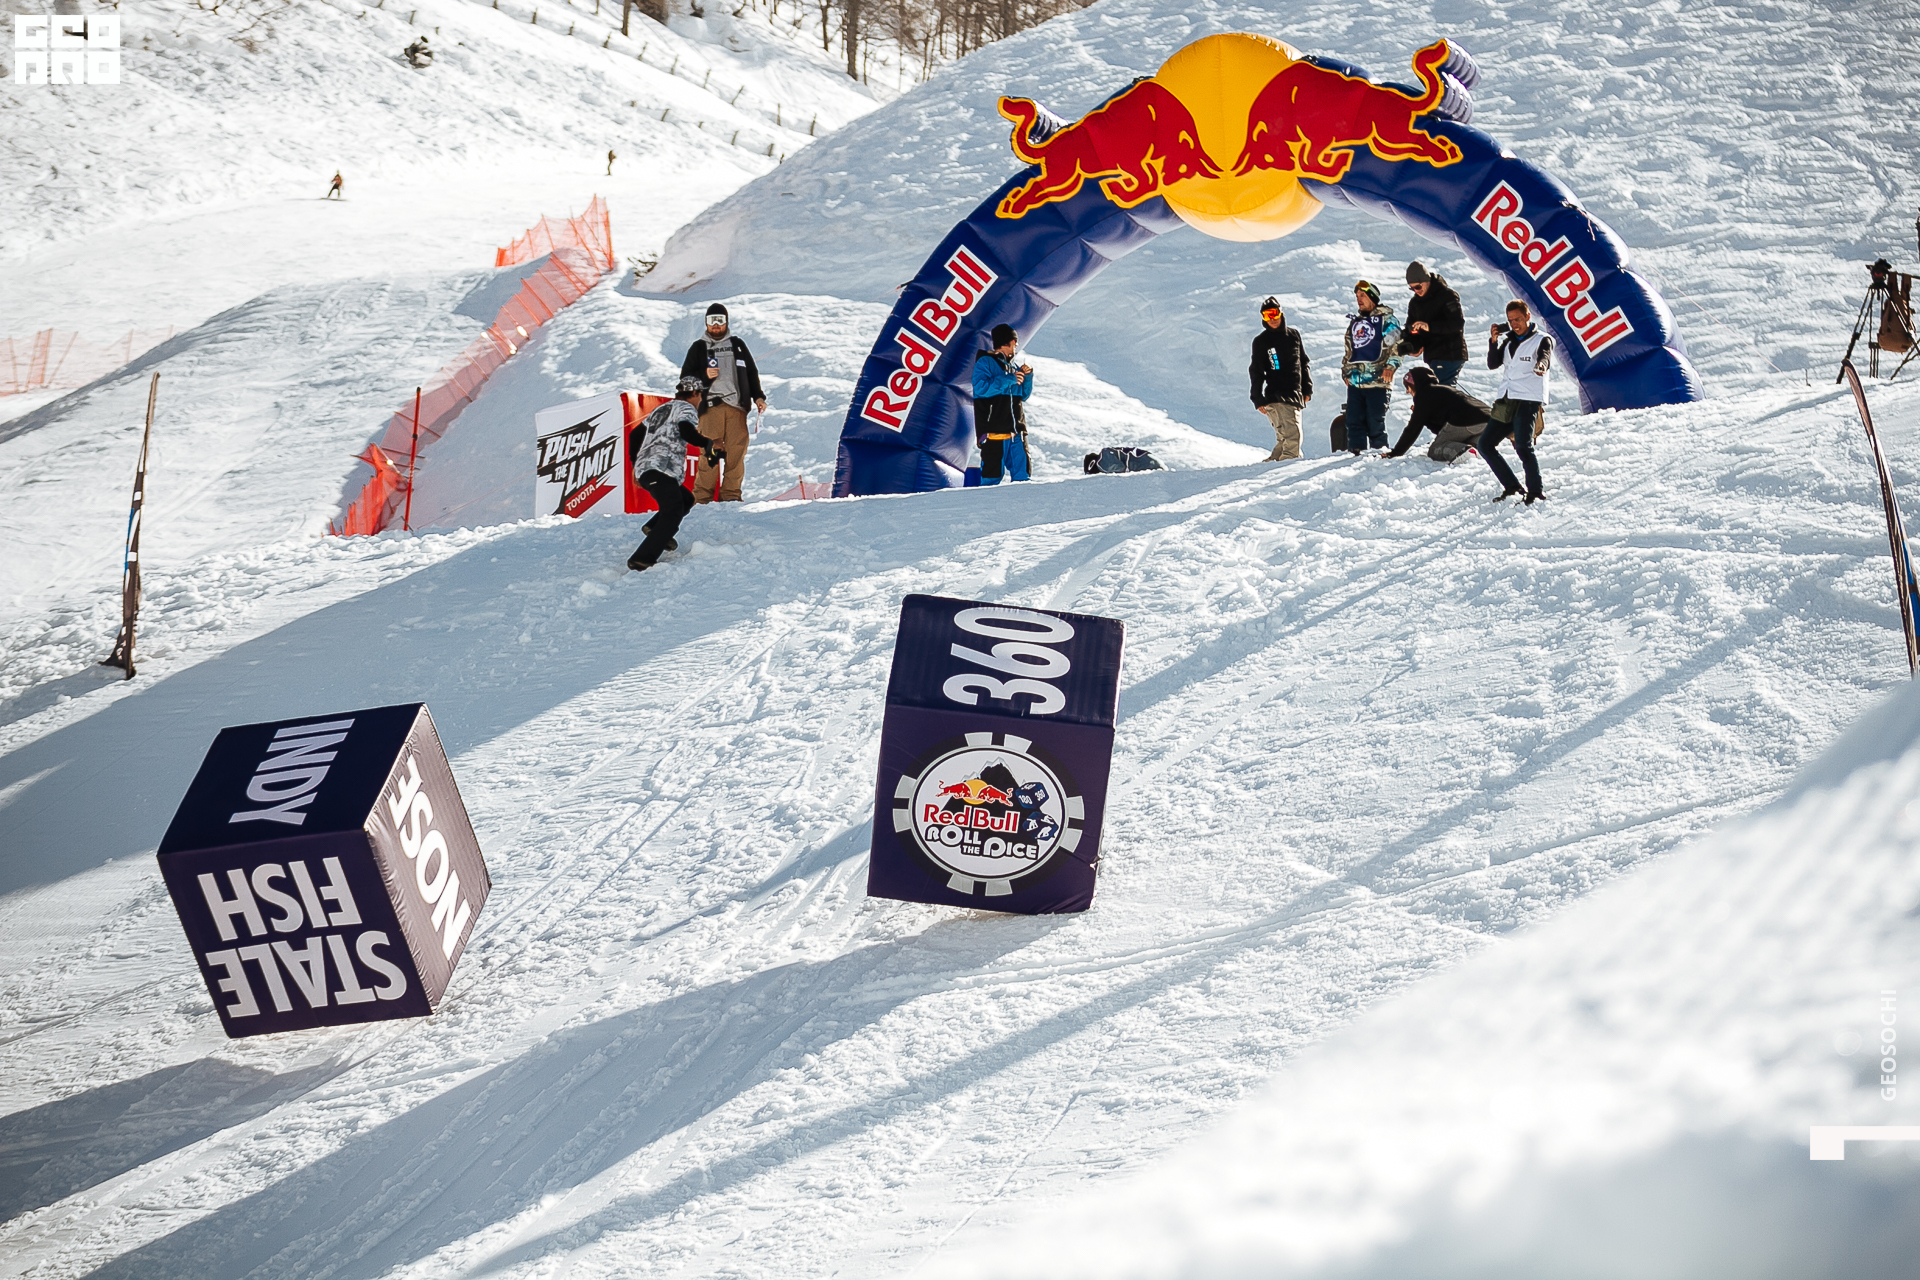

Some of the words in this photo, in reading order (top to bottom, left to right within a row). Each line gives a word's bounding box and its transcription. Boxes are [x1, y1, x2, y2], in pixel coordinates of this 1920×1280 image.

[1474, 183, 1570, 278] Red
[1543, 258, 1631, 354] Bull
[862, 330, 938, 430] Red
[910, 248, 994, 343] Bull
[542, 431, 591, 467] PUSH
[555, 463, 569, 480] THE
[564, 443, 613, 497] LIMIT
[566, 484, 596, 512] TOYOTA
[942, 606, 1075, 715] 360
[228, 718, 356, 826] INDY
[387, 754, 472, 962] NOSE
[923, 804, 971, 827] Red
[972, 808, 1020, 832] Bull
[926, 825, 982, 846] ROLL
[962, 845, 980, 855] THE
[983, 837, 1038, 859] DICE
[197, 856, 363, 942] FISH
[205, 930, 407, 1018] STALE
